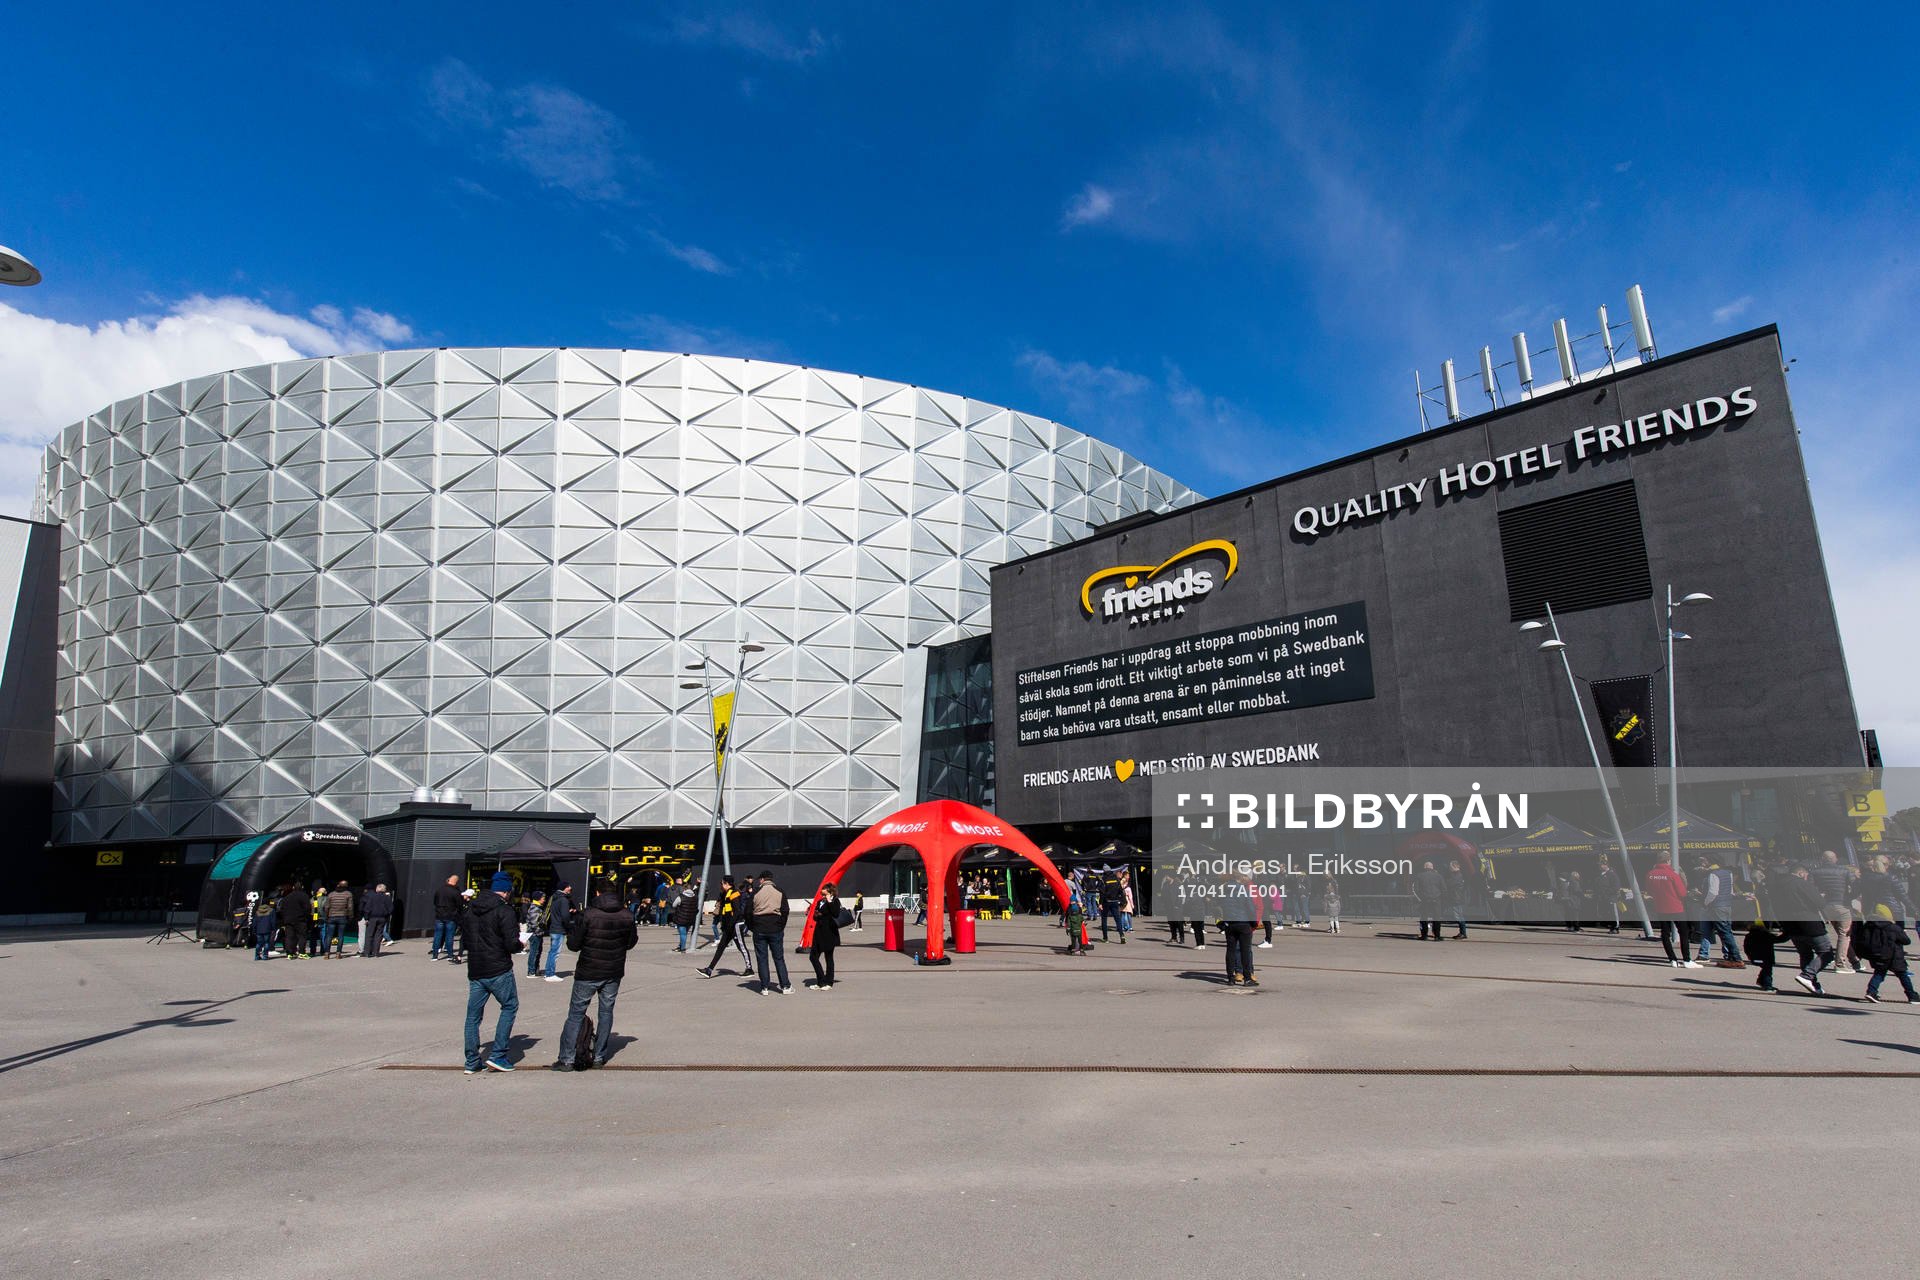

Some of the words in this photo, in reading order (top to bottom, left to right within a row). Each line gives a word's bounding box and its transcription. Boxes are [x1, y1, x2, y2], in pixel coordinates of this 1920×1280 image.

[1293, 477, 1428, 535] QUALITY
[1439, 443, 1562, 496] HOTEL
[1573, 386, 1758, 459] FRIENDS
[1102, 568, 1213, 616] friends
[1130, 605, 1185, 624] ARENA
[1019, 669, 1061, 685] Stiftelsen
[1064, 660, 1098, 676] Friends
[1102, 658, 1118, 669] har
[1121, 654, 1125, 665] i
[1128, 648, 1171, 665] uppdrag
[1175, 641, 1191, 655] att
[1195, 635, 1234, 651] stoppa
[1239, 621, 1300, 642] mobbning
[1304, 614, 1338, 630] inom
[1020, 689, 1043, 703] såväl
[1045, 685, 1070, 699] skola
[1073, 683, 1093, 694] som
[1096, 674, 1126, 690] idrott.
[1129, 670, 1145, 684] Ett
[1148, 663, 1182, 680] viktigt
[1187, 657, 1223, 674] arbete
[1228, 653, 1253, 666] som
[1257, 647, 1268, 661] vi
[1273, 643, 1289, 662] på
[1293, 630, 1365, 655] Swedbank
[1020, 708, 1053, 723] stödjer.
[1055, 700, 1091, 717] Namnet
[1094, 697, 1106, 714] på
[1109, 695, 1140, 708] denna
[1143, 689, 1174, 703] arena
[1177, 684, 1190, 697] är
[1193, 683, 1207, 695] en
[1211, 670, 1282, 695] påminnelse
[1286, 664, 1306, 680] att
[1310, 657, 1345, 678] inget
[1020, 729, 1041, 741] barn
[1043, 725, 1059, 738] ska
[1062, 721, 1096, 735] behöva
[1099, 718, 1121, 730] vara
[1124, 710, 1159, 726] utsatt,
[1162, 703, 1203, 721] ensamt
[1207, 700, 1235, 715] eller
[1239, 690, 1290, 710] mobbat.
[1023, 769, 1069, 788] FRIENDS
[1072, 765, 1112, 783] ARENA
[1140, 759, 1167, 777] MED
[1171, 753, 1205, 774] STÖD
[1210, 752, 1227, 770] AV
[1231, 743, 1320, 768] SWEDBANK
[1853, 794, 1871, 812] B
[315, 832, 358, 842] Speedshooting
[893, 821, 929, 834] MORE
[963, 824, 1004, 837] MORE
[100, 853, 121, 864] Cx
[1683, 841, 1740, 850] MERCHANDISE
